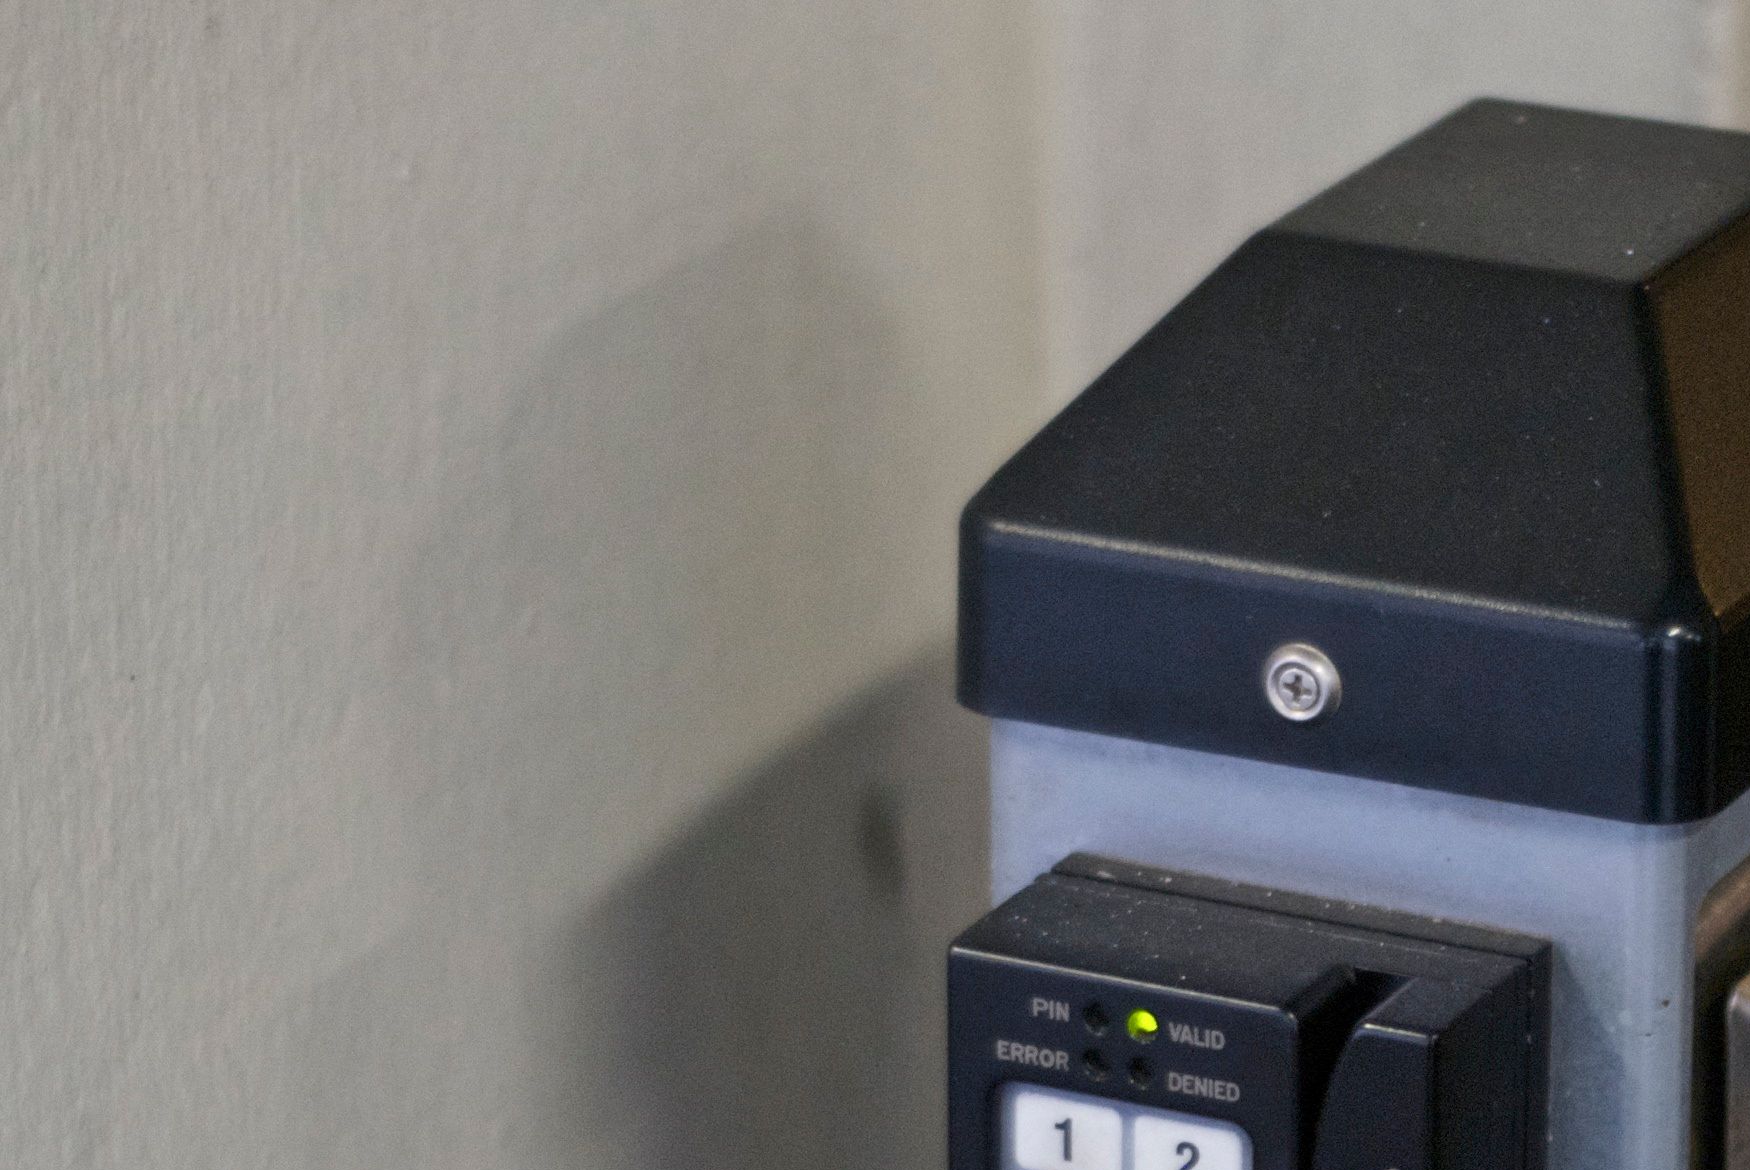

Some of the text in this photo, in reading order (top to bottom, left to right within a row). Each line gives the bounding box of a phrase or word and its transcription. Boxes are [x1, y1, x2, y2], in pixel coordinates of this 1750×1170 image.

[1031, 997, 1070, 1022] PIN
[1168, 1022, 1226, 1051] VALID
[996, 1039, 1070, 1072] ERROR
[1167, 1072, 1241, 1102] DENIED
[1054, 1117, 1073, 1162] 1
